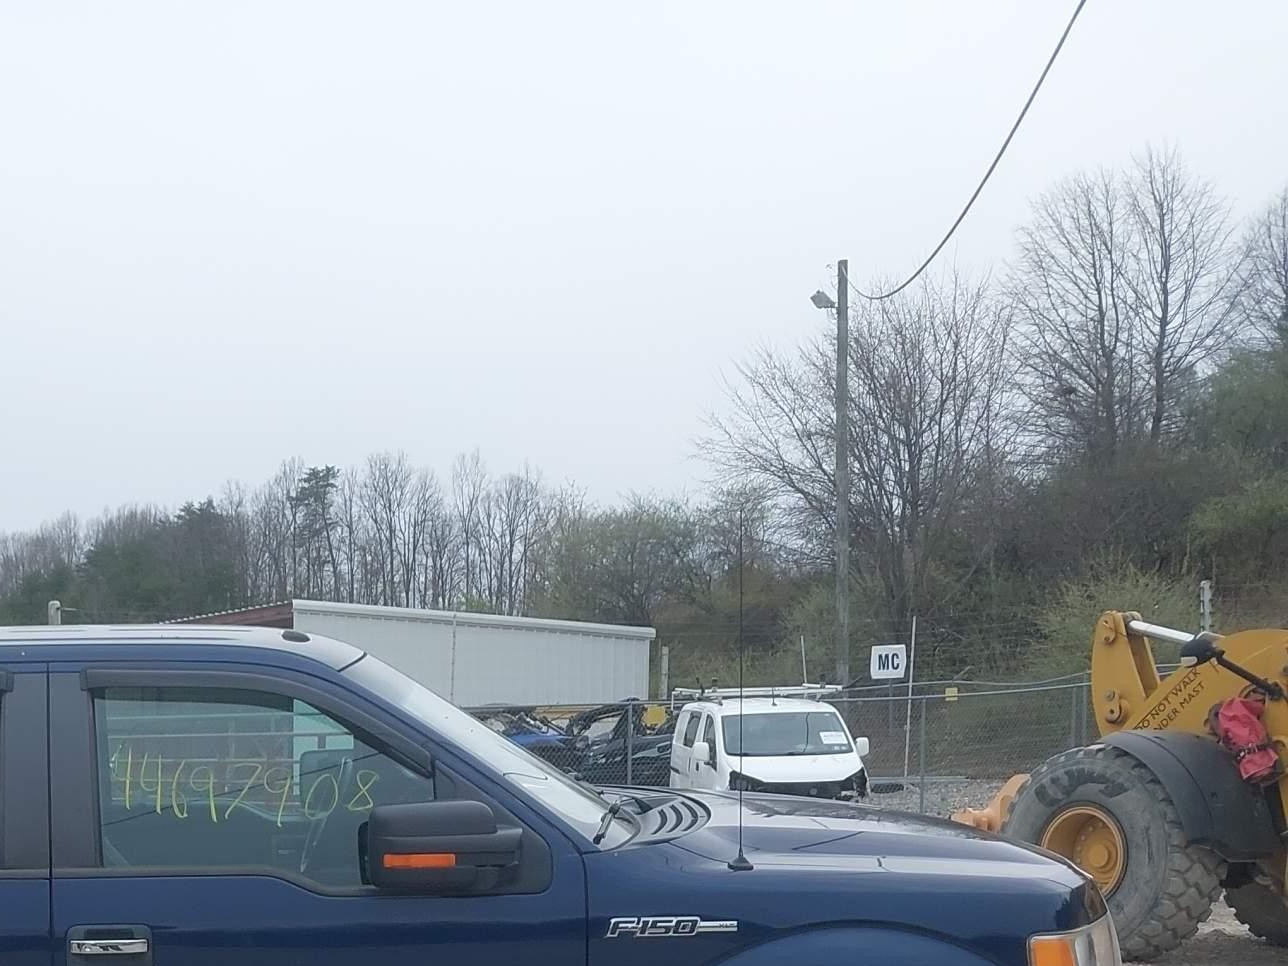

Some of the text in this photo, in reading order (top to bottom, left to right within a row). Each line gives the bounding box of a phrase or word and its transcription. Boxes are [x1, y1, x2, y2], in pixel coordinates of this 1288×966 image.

[878, 653, 900, 670] MC
[1151, 694, 1173, 719] NOT
[1172, 667, 1201, 698] WALK
[1153, 681, 1205, 731] NDER MAST
[110, 743, 380, 828] 44697908
[604, 915, 701, 938] F-150
